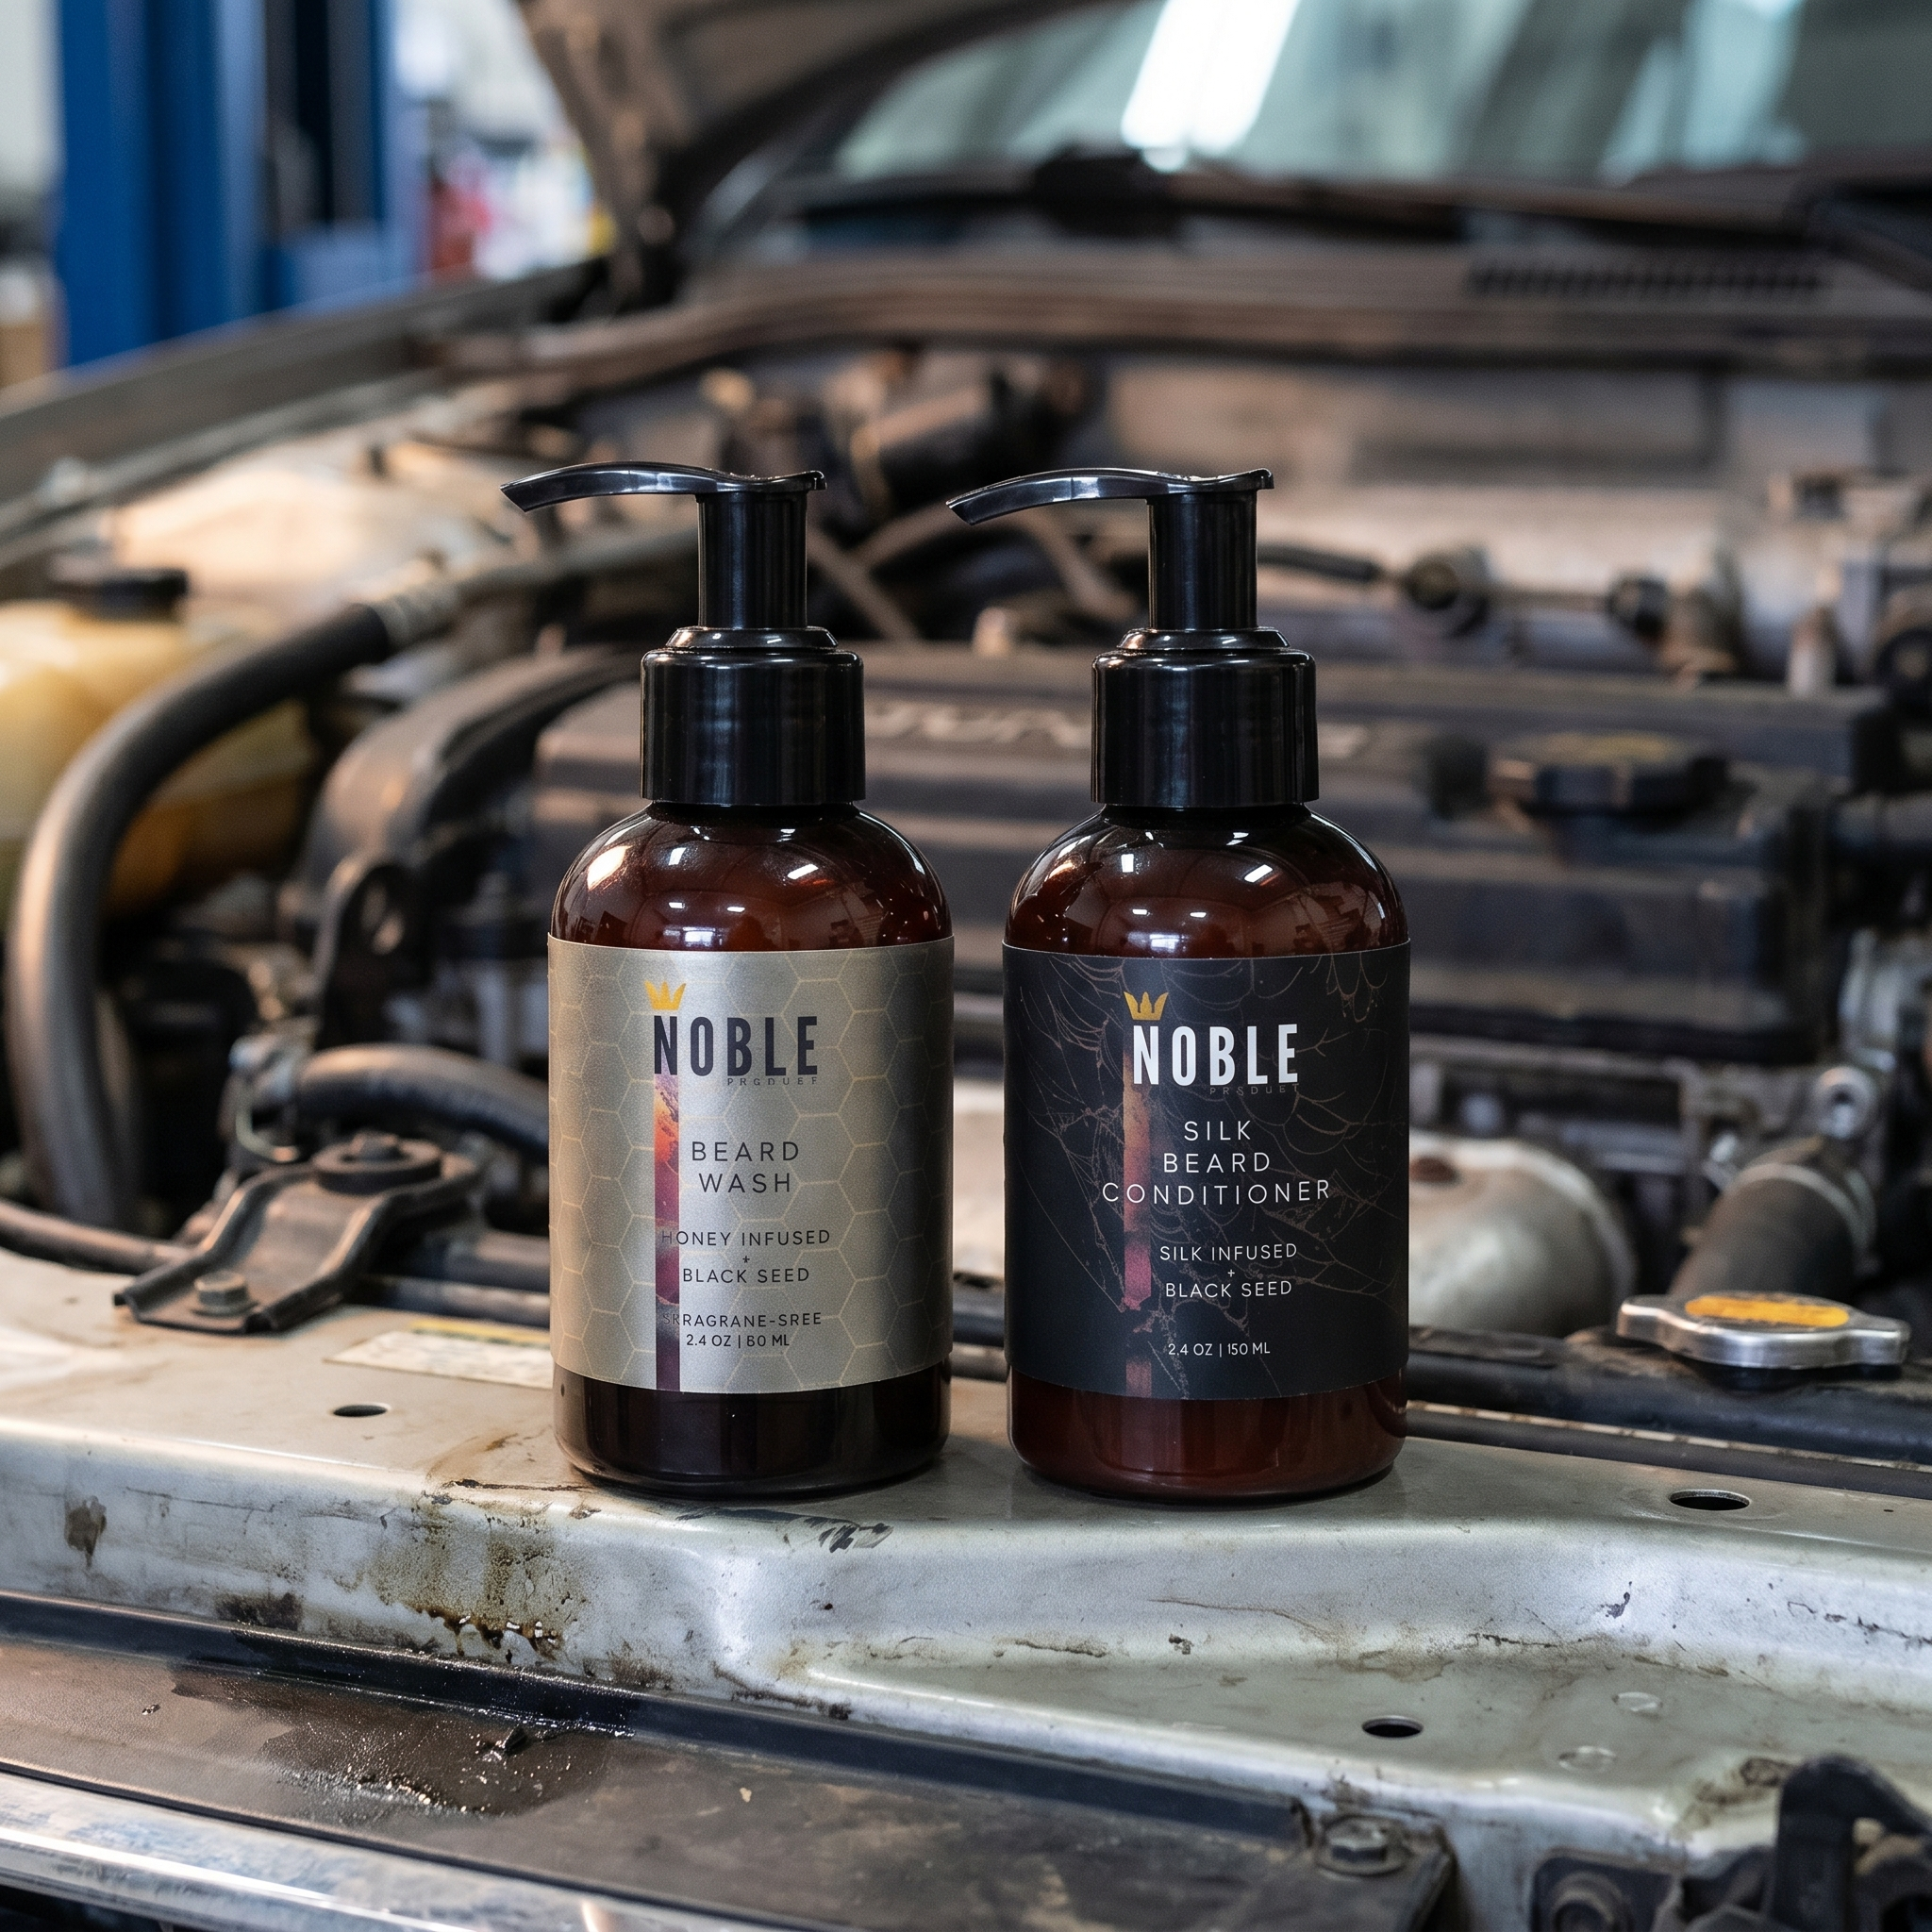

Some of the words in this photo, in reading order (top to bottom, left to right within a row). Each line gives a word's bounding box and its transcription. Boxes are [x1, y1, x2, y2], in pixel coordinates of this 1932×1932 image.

[654, 1015, 818, 1077] NOBLE
[1133, 1024, 1298, 1086] NOBLE
[1183, 1120, 1251, 1141] SILK
[691, 1141, 799, 1162] BEARD
[1163, 1152, 1271, 1174] BEARD
[699, 1173, 791, 1193] WASH
[1102, 1180, 1330, 1206] CONDITIONER
[661, 1230, 731, 1246] HONEY
[741, 1229, 830, 1246] INFUSED
[1159, 1245, 1202, 1261] SILK
[1211, 1242, 1297, 1261] INFUSED
[683, 1268, 747, 1284] BLACK
[758, 1267, 809, 1283] SEED
[1165, 1282, 1232, 1298] BLACK
[1241, 1280, 1291, 1297] SEED
[686, 1333, 707, 1346] 2.4
[711, 1334, 732, 1347] OZ
[772, 1334, 790, 1347] ML
[1168, 1342, 1189, 1357] 2.4
[1192, 1342, 1213, 1357] OZ
[1227, 1342, 1249, 1356] 150
[1252, 1341, 1271, 1356] ML
